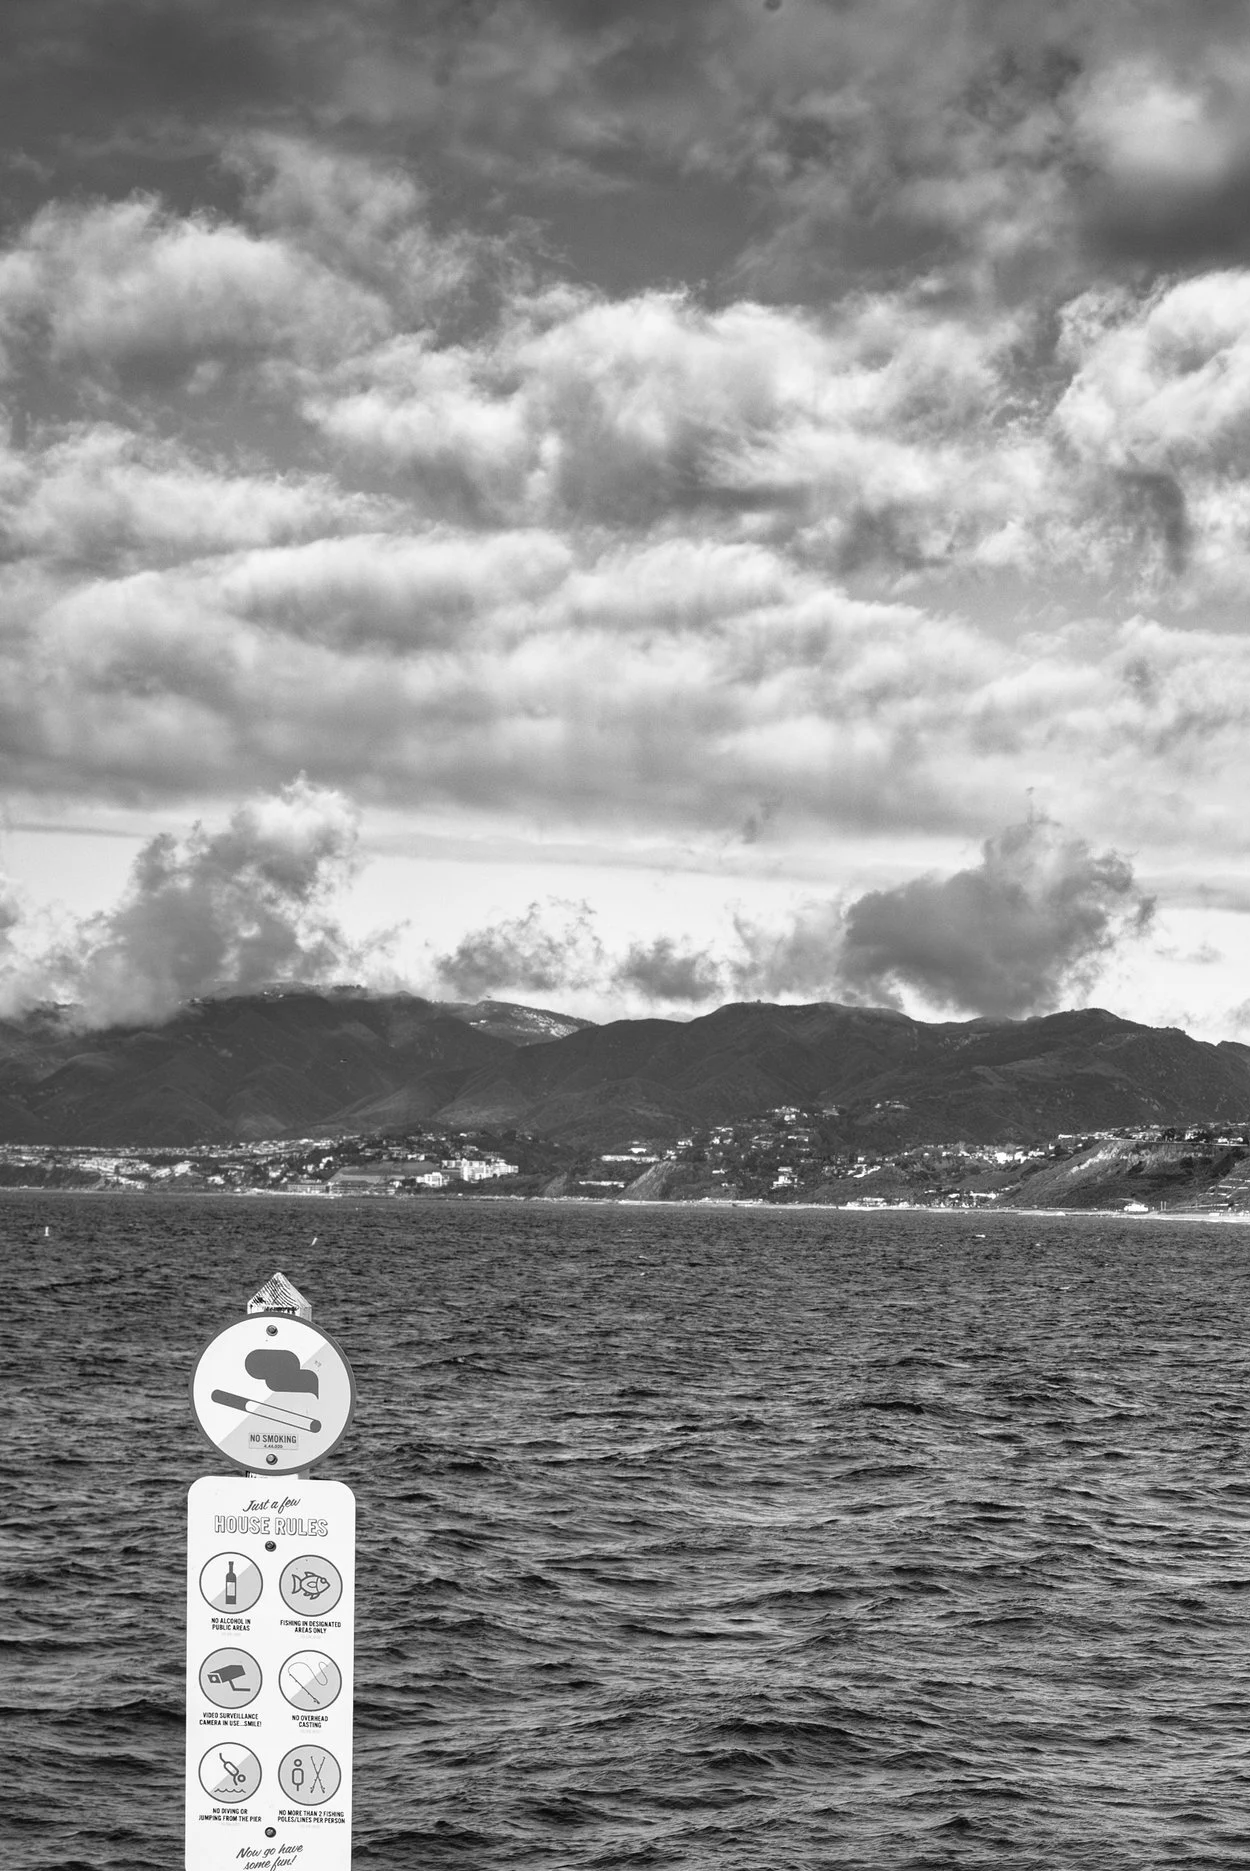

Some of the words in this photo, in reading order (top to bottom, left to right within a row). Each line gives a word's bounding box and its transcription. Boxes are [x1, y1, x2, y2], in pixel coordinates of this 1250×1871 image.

[250, 1434, 260, 1442] NO
[262, 1434, 296, 1444] SMOKING
[242, 1499, 270, 1512] Just
[270, 1501, 279, 1509] a
[277, 1496, 301, 1514] few
[214, 1515, 270, 1535] HOUSE
[275, 1517, 328, 1537] RULES
[236, 1847, 262, 1859] Now
[262, 1848, 276, 1858] go
[278, 1843, 303, 1854] have
[243, 1860, 271, 1870] some
